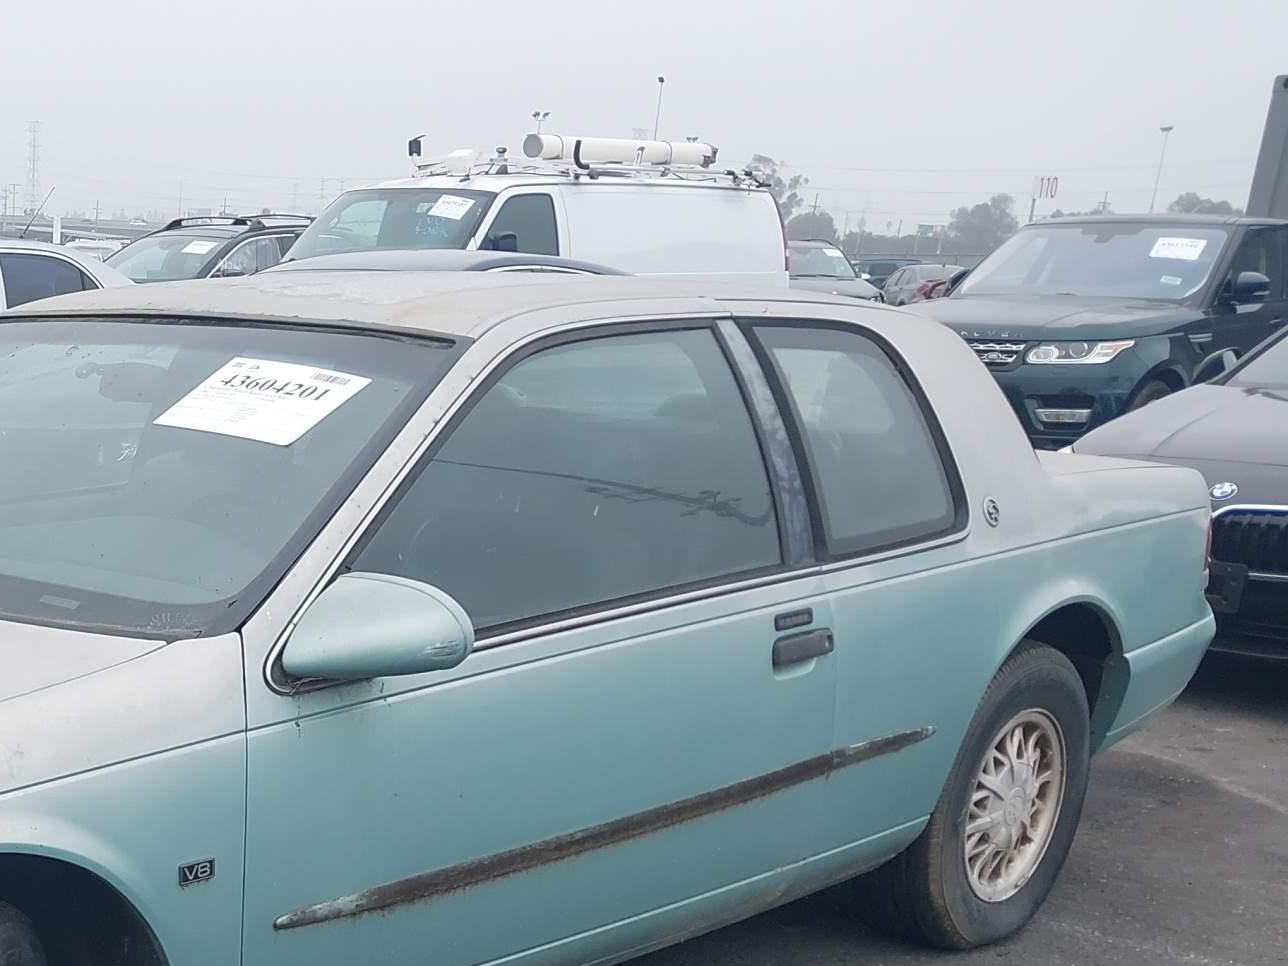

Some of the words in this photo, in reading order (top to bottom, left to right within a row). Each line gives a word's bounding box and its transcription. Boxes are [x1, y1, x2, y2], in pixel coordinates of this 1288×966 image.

[1039, 176, 1058, 199] 110
[220, 374, 331, 401] 43604201
[183, 862, 211, 880] V8
